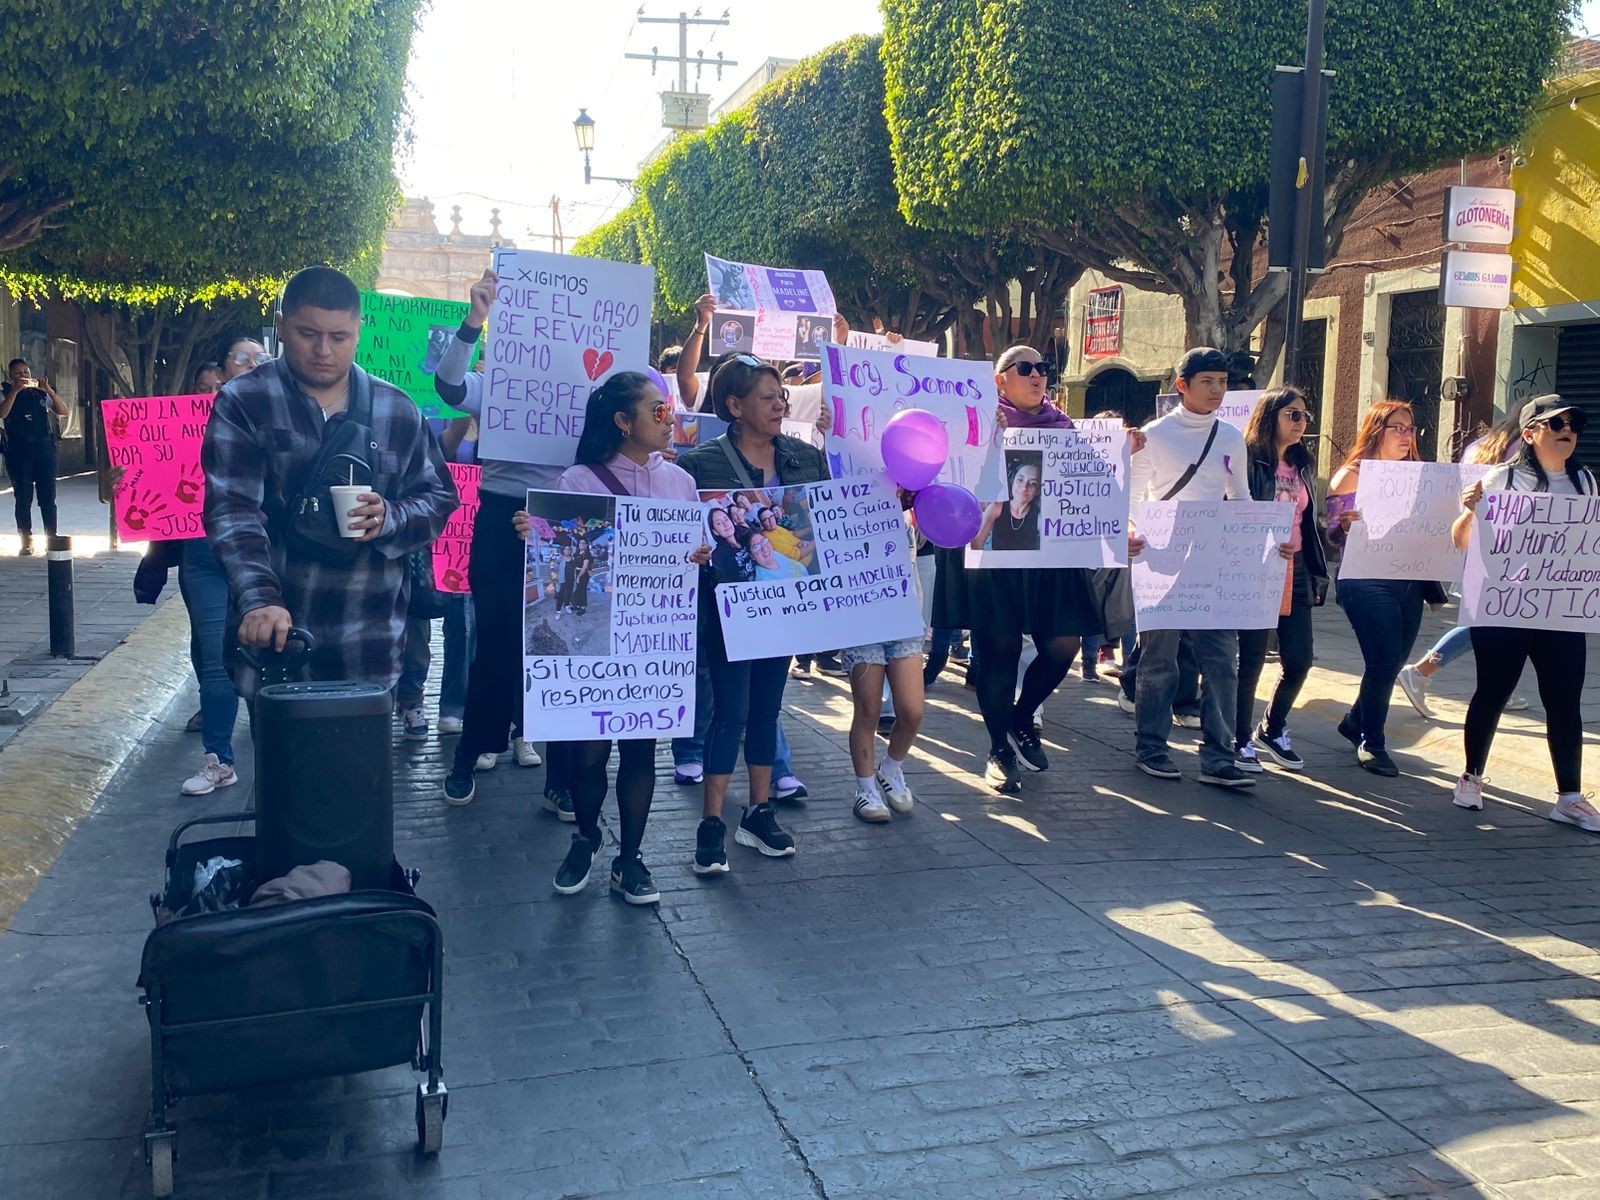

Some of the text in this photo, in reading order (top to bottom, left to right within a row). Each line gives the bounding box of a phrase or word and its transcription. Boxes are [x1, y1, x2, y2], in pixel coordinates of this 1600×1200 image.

[1456, 207, 1510, 231] GLOTONERÍA
[497, 253, 588, 295] EXIGIMOS
[772, 286, 810, 297] MADELINE
[497, 285, 639, 328] QUE EL CASO
[389, 317, 411, 333] NO
[497, 311, 621, 350] SE REVISE
[373, 335, 389, 350] NI
[389, 354, 406, 368] NI
[493, 340, 550, 371] COMO
[826, 346, 982, 400] Hoy Somos
[119, 401, 148, 423] SOY
[158, 400, 180, 420] LA
[488, 406, 516, 430] DE
[1018, 430, 1034, 445] tu
[111, 444, 174, 467] POR SU
[814, 507, 847, 523] nos
[1058, 499, 1089, 516] Para
[817, 518, 900, 542] tu historia
[1044, 516, 1121, 537] Madeline
[1175, 527, 1194, 536] con
[620, 552, 680, 566] hermana,
[616, 572, 684, 590] memoria
[795, 574, 842, 599] para
[617, 592, 645, 607] nos
[746, 579, 908, 619] sin más PROMESAS!
[1485, 586, 1600, 619] JUSTIC
[671, 613, 696, 627] para
[568, 658, 637, 680] tocan
[541, 683, 684, 706] respondemos
[592, 705, 686, 735] TODAS!
